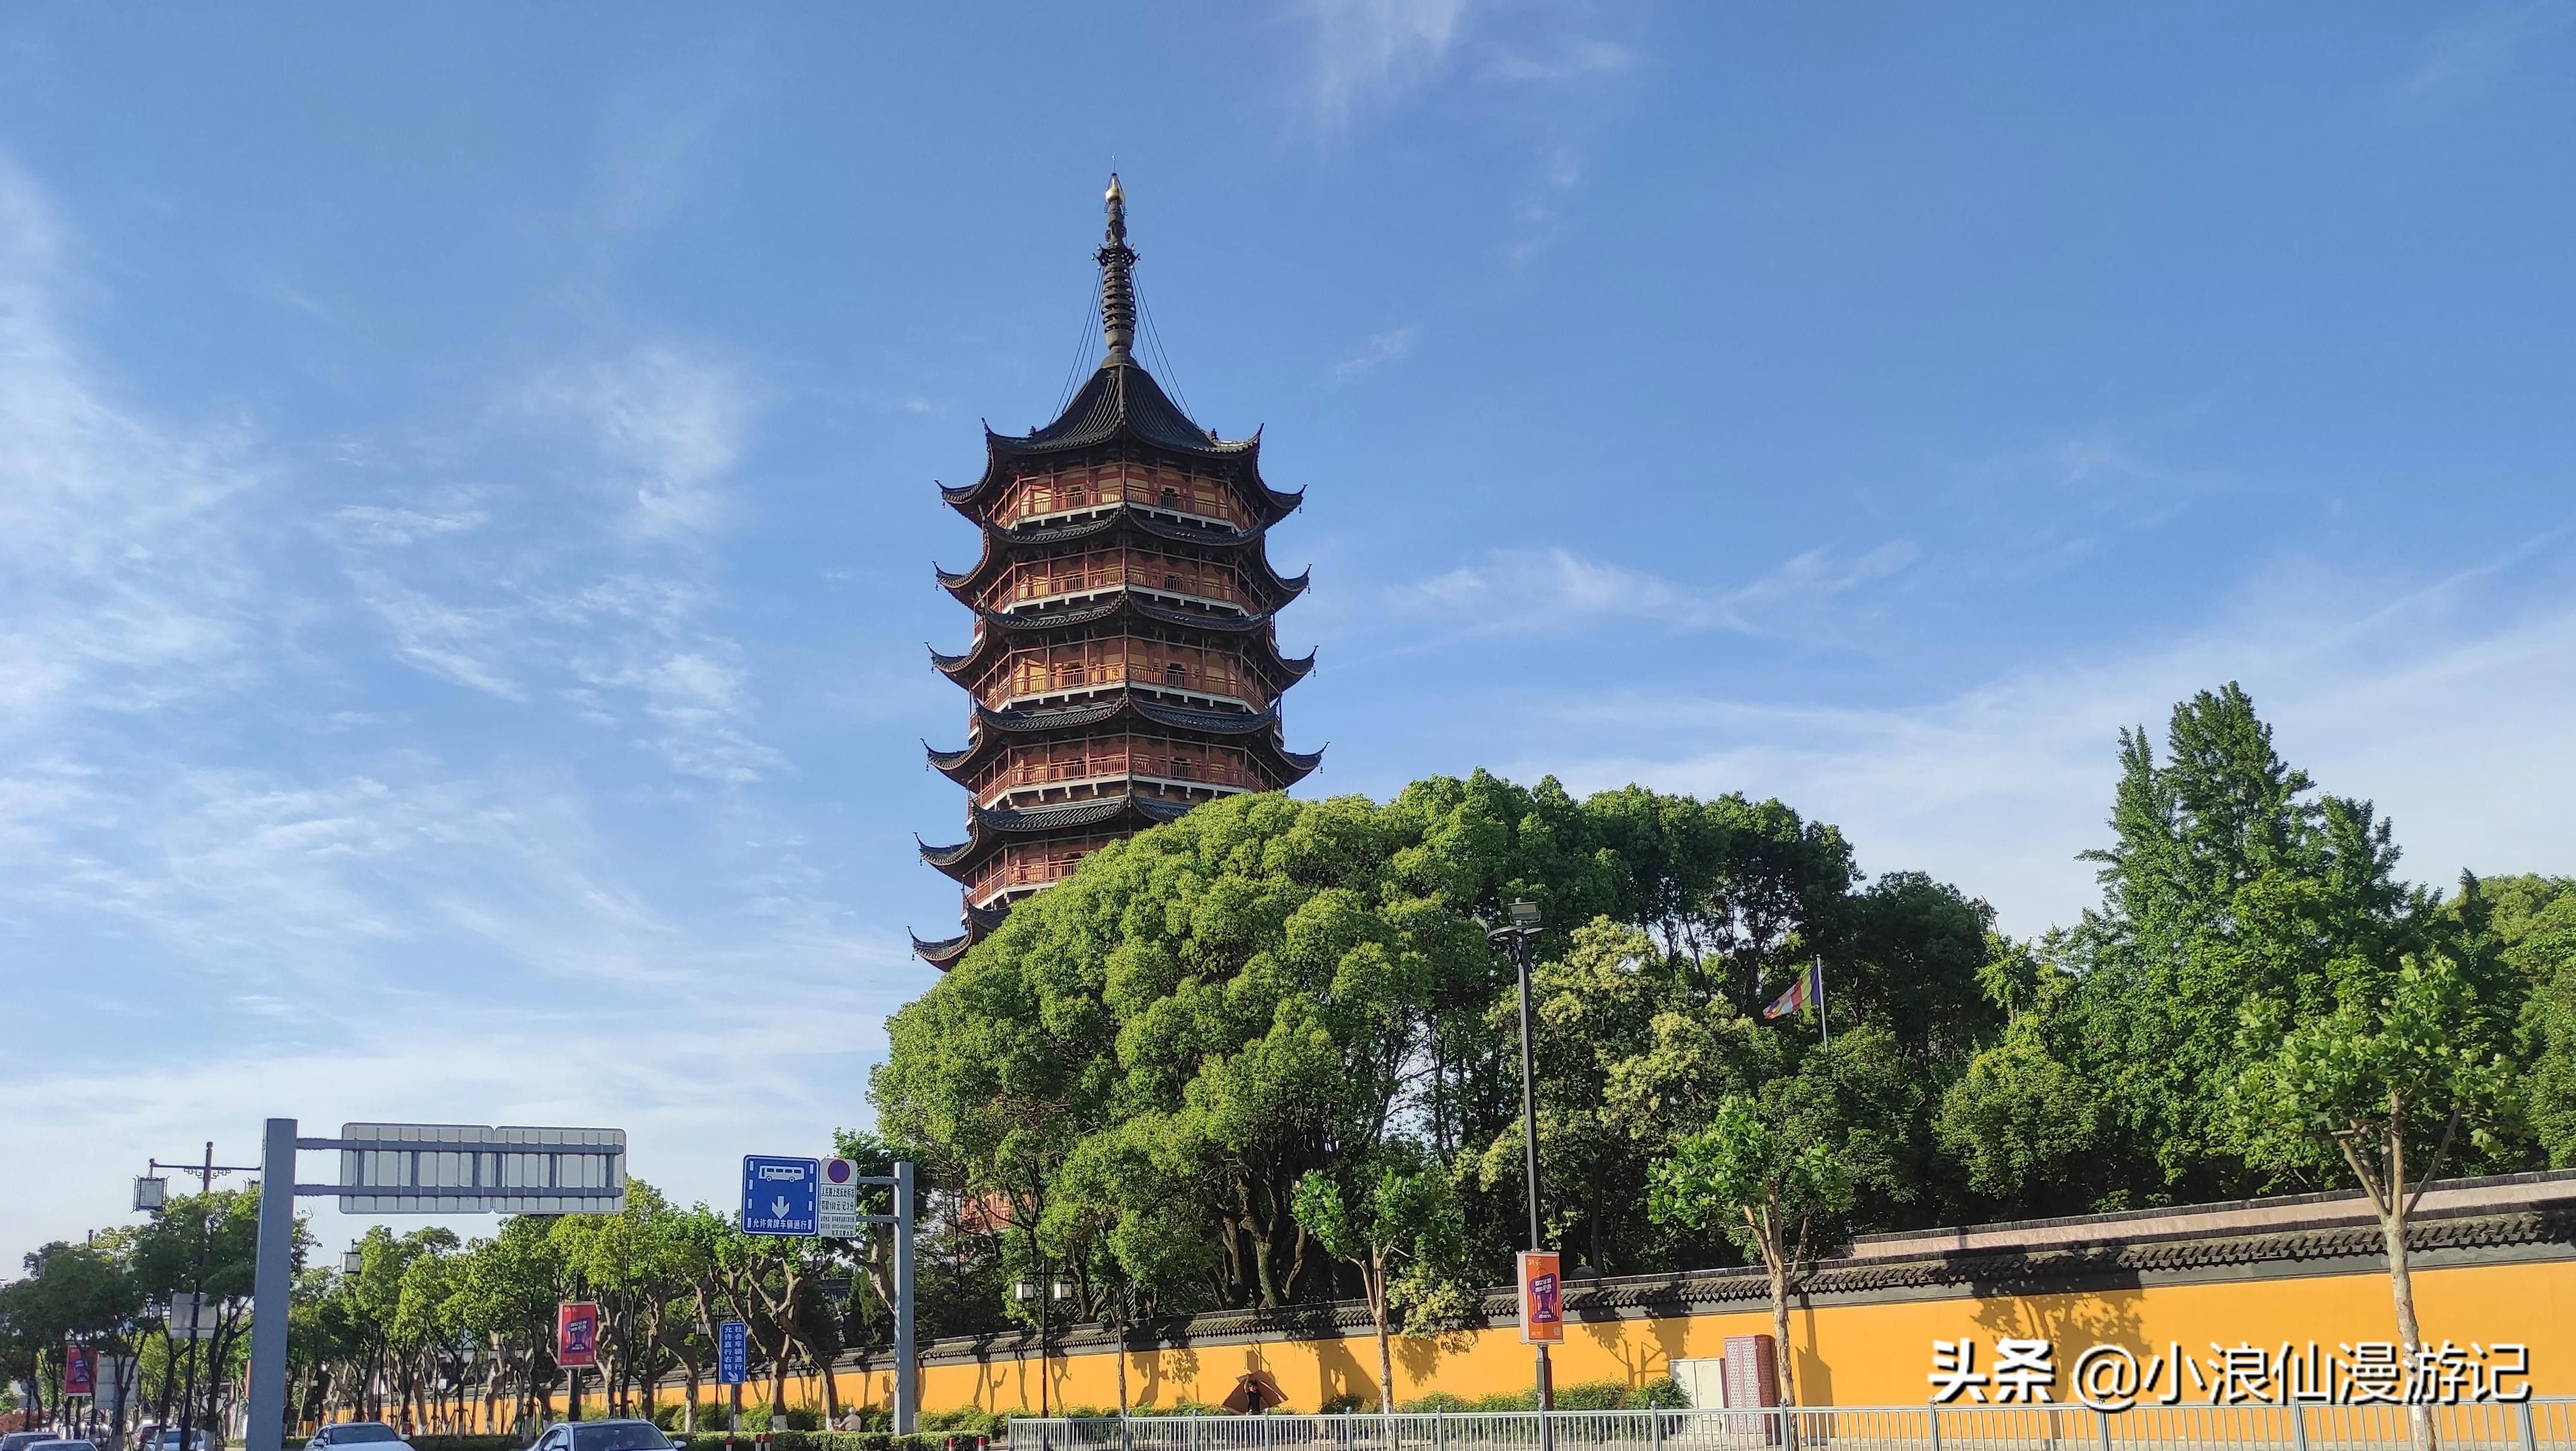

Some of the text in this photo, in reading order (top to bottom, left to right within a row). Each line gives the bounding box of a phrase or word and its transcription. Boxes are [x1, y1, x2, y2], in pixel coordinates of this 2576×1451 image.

[753, 1218, 807, 1230] 允许黄牌车辆通行
[724, 1326, 733, 1370] 允许直行右转
[734, 1326, 743, 1370] 社会车辆通行
